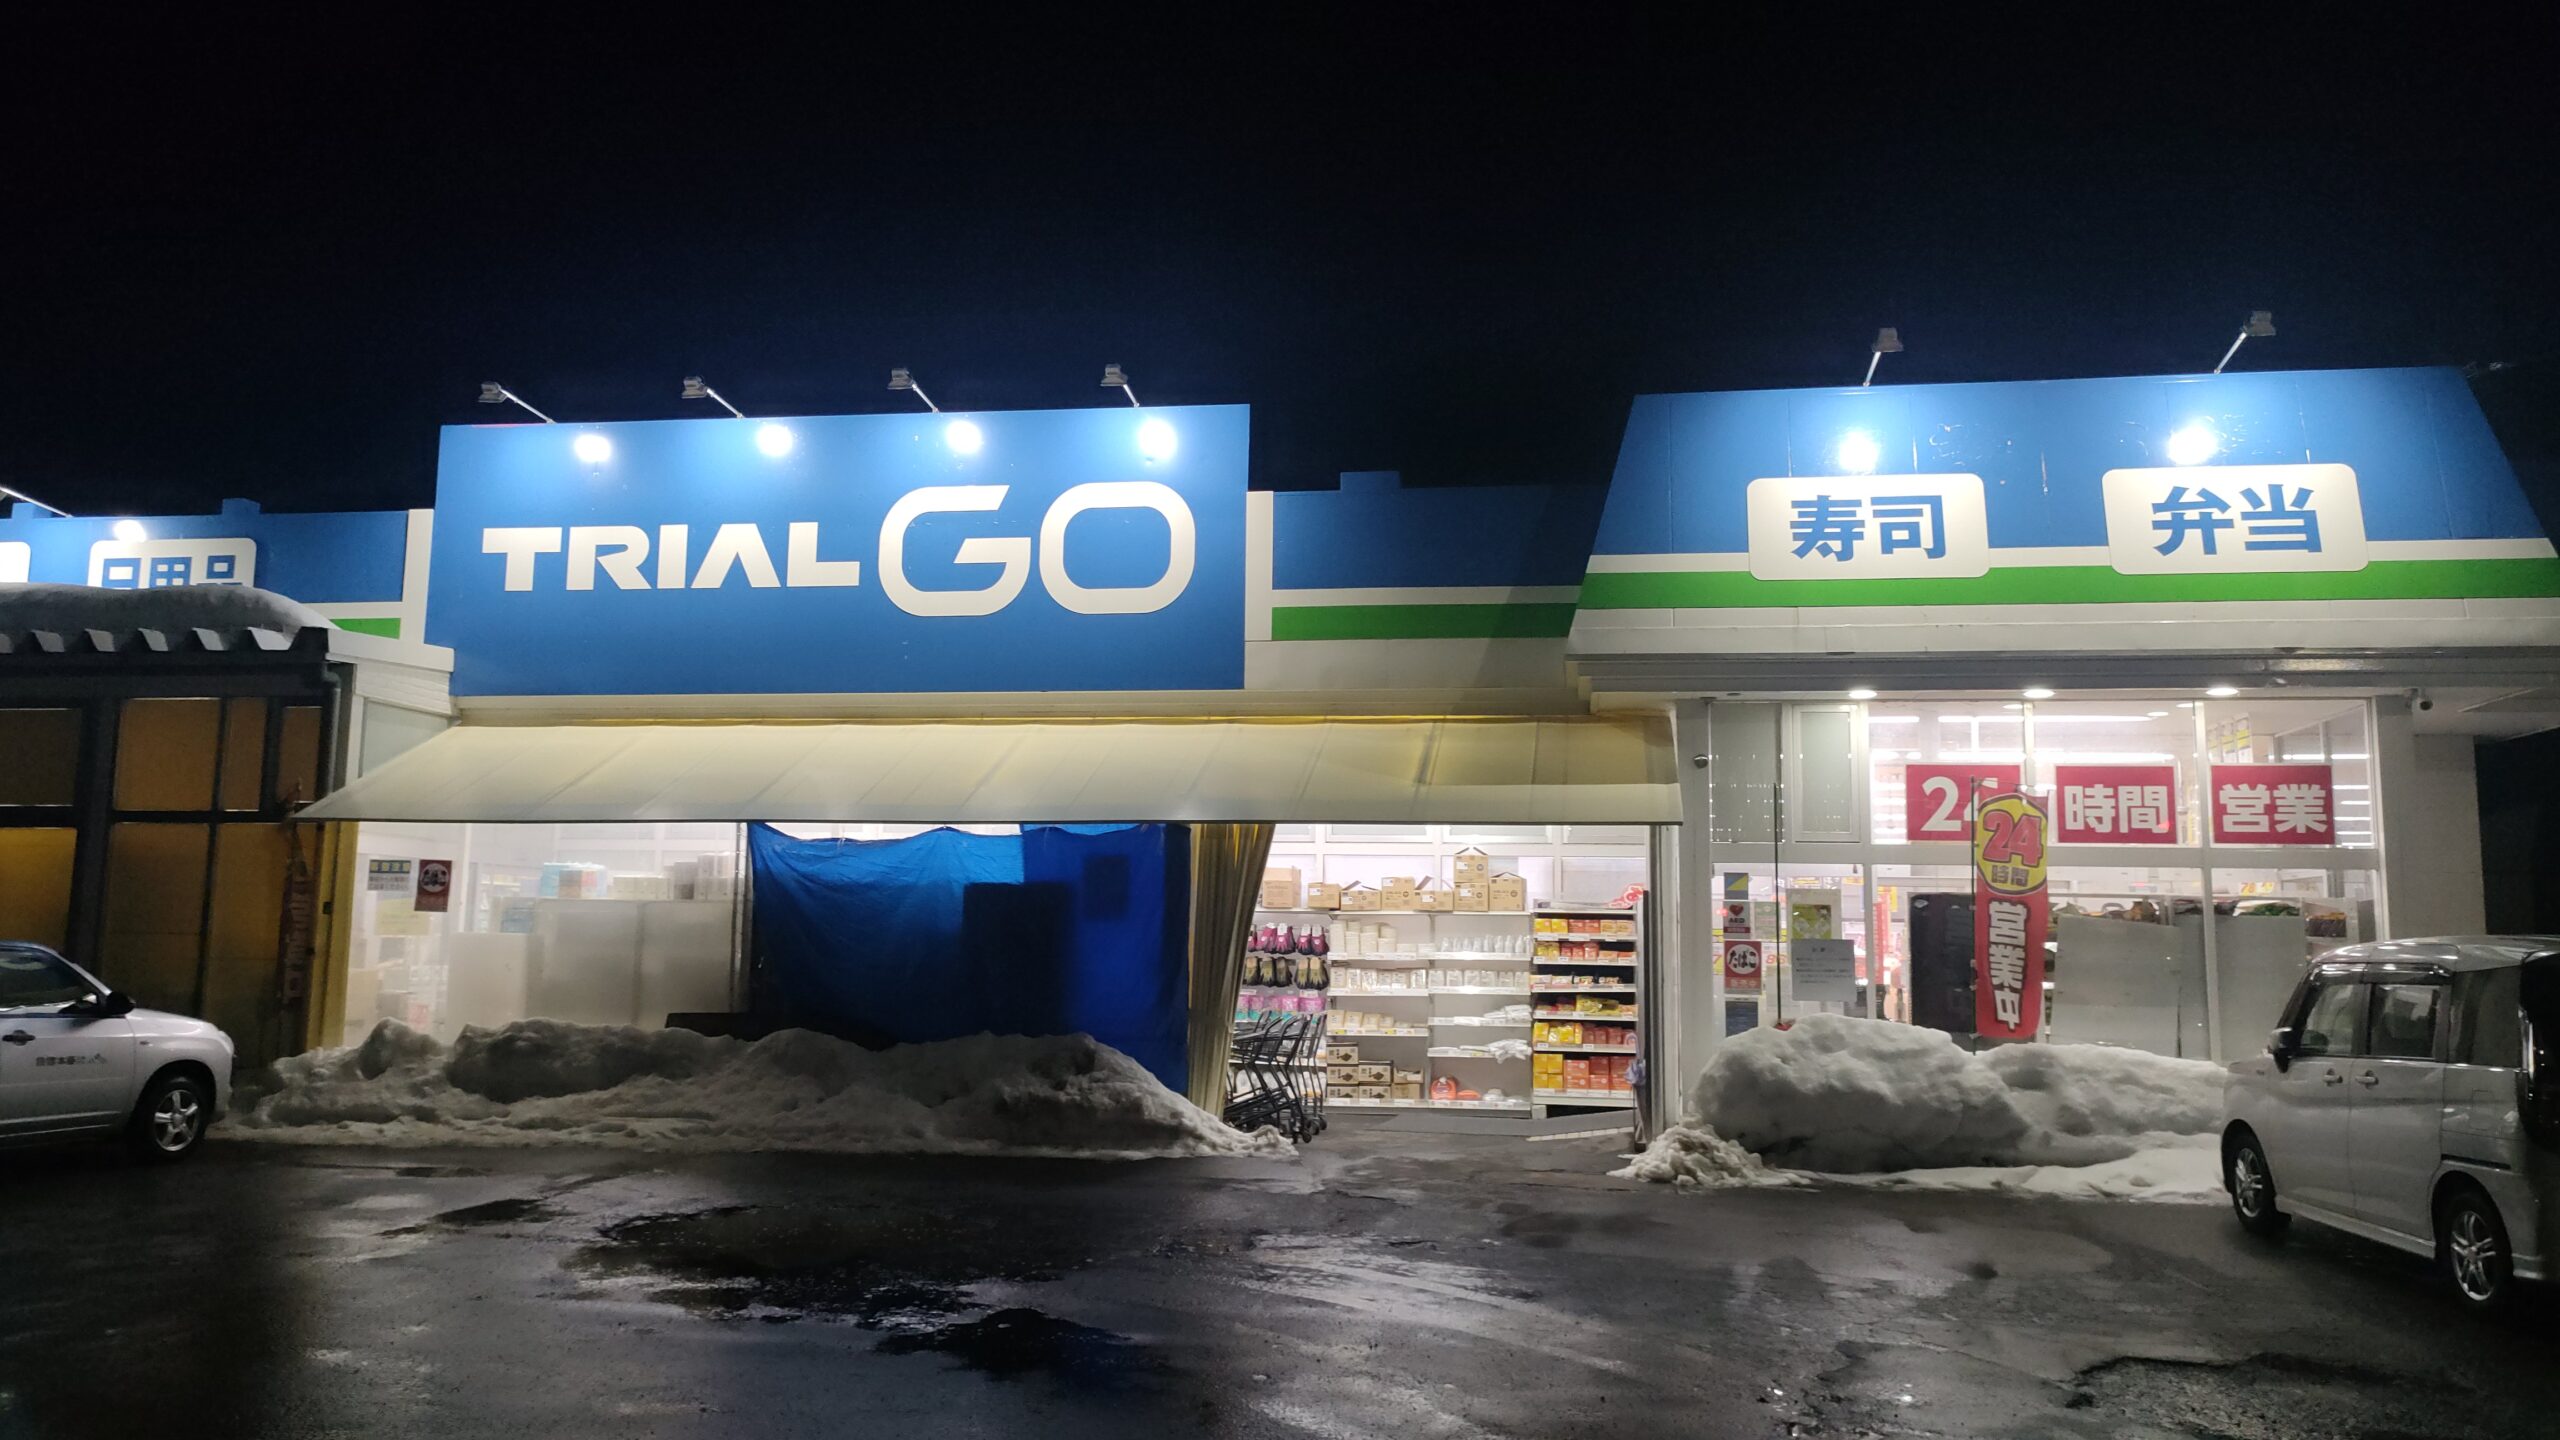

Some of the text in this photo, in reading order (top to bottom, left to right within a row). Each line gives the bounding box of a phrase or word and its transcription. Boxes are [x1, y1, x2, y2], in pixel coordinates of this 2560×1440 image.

[482, 481, 1197, 617] TRIAL GO
[1789, 494, 1947, 562] 寿司
[2151, 483, 2323, 556] 弁当
[1982, 807, 2044, 867] 24
[2064, 784, 2169, 834] 時間
[2219, 783, 2328, 834] 営業
[1991, 864, 2029, 888] 時間
[1728, 949, 1758, 969] たばこ
[1988, 899, 2029, 1033] 営業中
